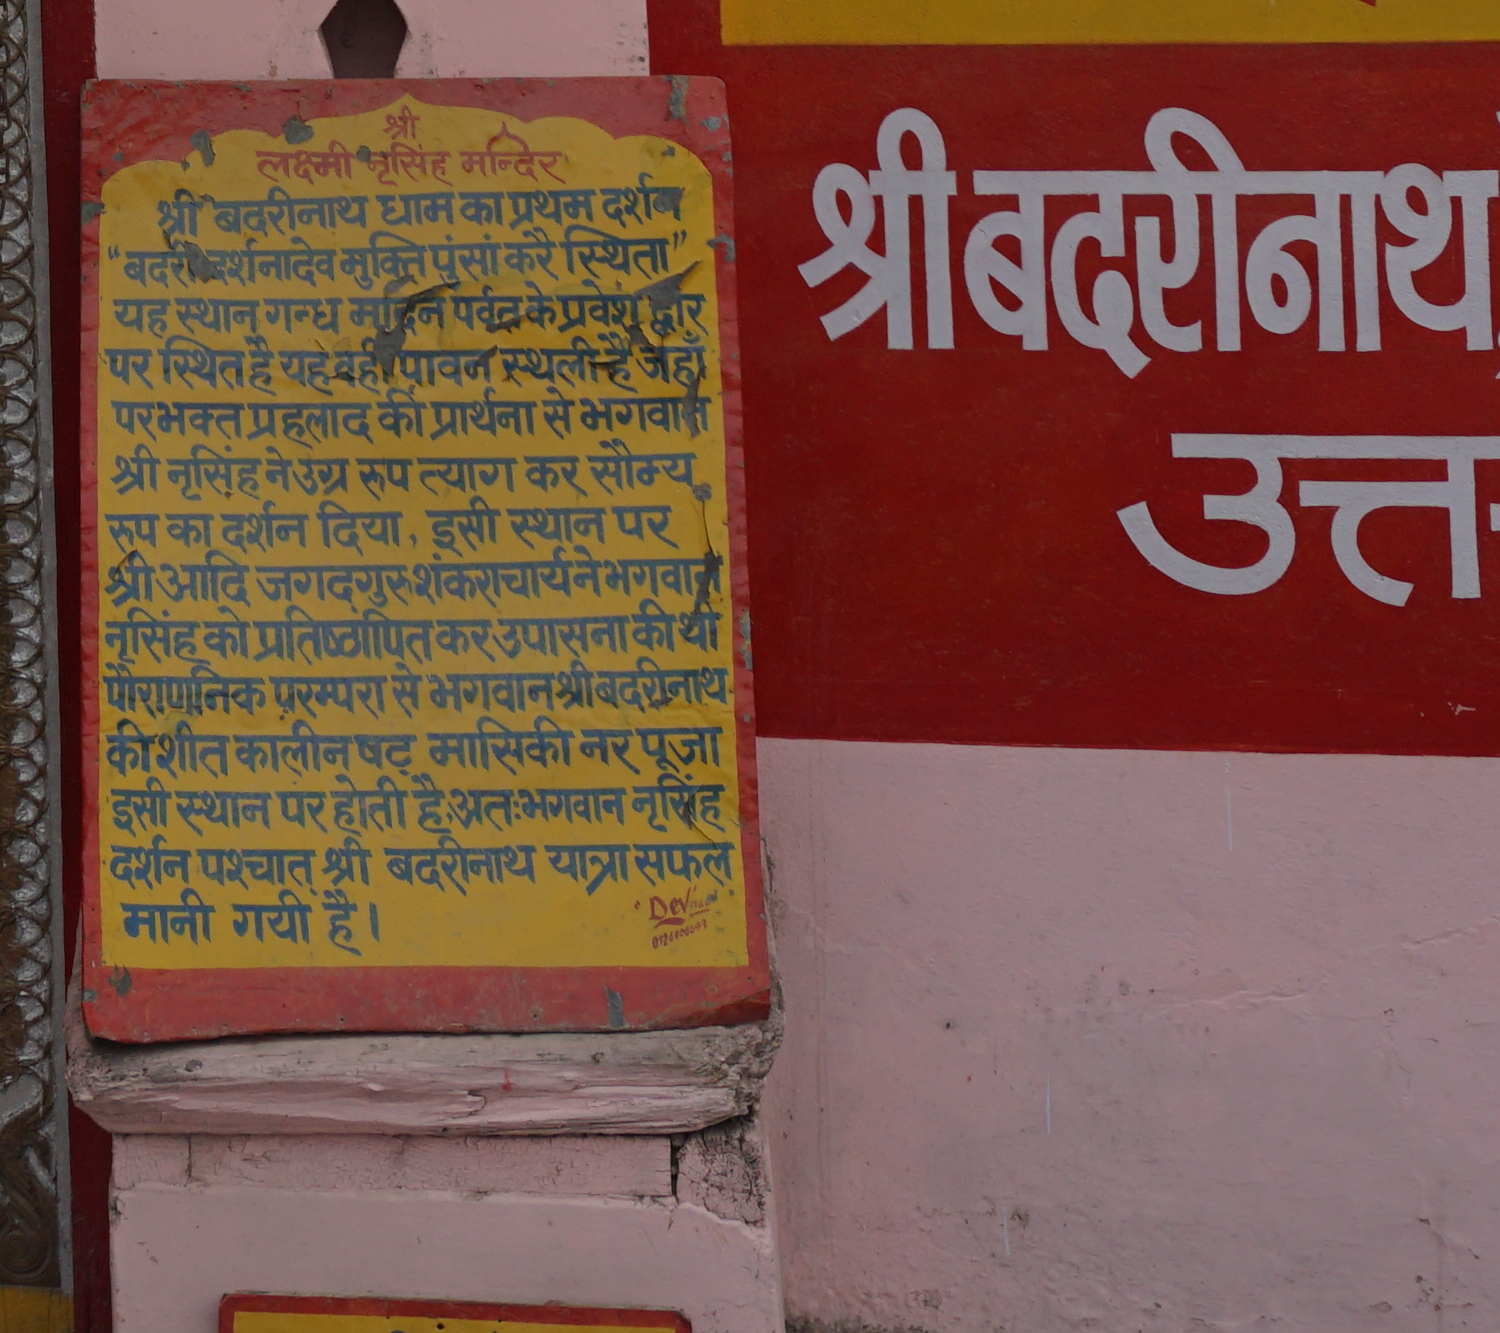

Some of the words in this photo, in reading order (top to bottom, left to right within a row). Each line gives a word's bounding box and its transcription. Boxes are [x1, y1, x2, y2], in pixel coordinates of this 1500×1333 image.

[255, 139, 352, 185] लक्ष्मी
[366, 141, 453, 187] नृसिंह
[459, 121, 567, 185] मन्दिर
[383, 104, 420, 140] श्री
[157, 188, 204, 237] श्री
[213, 186, 370, 237] बदरीनाथ
[459, 190, 504, 227] का
[507, 188, 597, 231] प्रथम
[796, 106, 957, 351] श्री
[205, 236, 336, 287] दर्शनादेव
[340, 231, 427, 291] मुक्ति
[113, 298, 171, 340] यह
[174, 297, 259, 335] स्थान
[451, 285, 524, 332] पर्वत
[525, 280, 558, 330] के
[555, 279, 643, 334] प्रवेश
[105, 348, 154, 390] पर
[157, 335, 245, 389] स्थित
[244, 335, 277, 397] है
[278, 349, 334, 396] यह
[397, 347, 498, 388] पावन
[500, 336, 600, 388] स्थली
[602, 331, 639, 393] है
[111, 400, 157, 442] पर
[157, 401, 246, 441] भक्त
[430, 386, 537, 441] प्रार्थना
[541, 386, 577, 440] से
[110, 443, 162, 496] श्री
[167, 444, 263, 501] नृसिंह
[265, 445, 294, 493] ने
[292, 457, 350, 497] उग्र
[417, 456, 519, 496] त्याग
[523, 454, 588, 498] कर
[586, 437, 698, 496] सौम्य
[165, 513, 214, 549] का
[220, 499, 310, 555] दर्शन
[424, 495, 502, 558] इसी
[506, 506, 607, 550] स्थान
[612, 504, 681, 550] पर
[105, 549, 157, 608] श्री
[156, 549, 251, 608] आदि
[412, 545, 573, 609] शंकराचार्य
[572, 544, 602, 598] ने
[104, 606, 211, 666] नृसिंह
[202, 606, 251, 660] को
[252, 604, 435, 666] प्रतिष्ठापित
[436, 618, 497, 663] कर
[492, 615, 630, 660] उपासना
[631, 598, 677, 654] की
[269, 675, 388, 720] परम्परा
[390, 661, 422, 720] से
[429, 671, 556, 713] भगवान
[556, 659, 594, 711] श्री
[593, 656, 729, 714] बदरीनाथ
[106, 718, 154, 777] की
[155, 719, 230, 779] शीत
[233, 719, 351, 777] कालीन
[427, 715, 576, 776] मासिकी
[578, 728, 641, 776] नर
[635, 726, 724, 774] पूजा
[111, 776, 172, 838] इसी
[175, 789, 273, 837] स्थान
[276, 790, 328, 833] पर
[330, 774, 409, 837] होती
[517, 786, 627, 826] भगवान
[631, 773, 726, 834] नृसिंह
[109, 834, 192, 890] दर्शन
[196, 847, 319, 896] पश्चात्
[320, 836, 372, 885] श्री
[384, 835, 538, 897] बदरीनाथ
[543, 844, 632, 897] यात्रा
[633, 842, 736, 888] सफल
[120, 887, 217, 946] मानी
[232, 889, 314, 945] गयी
